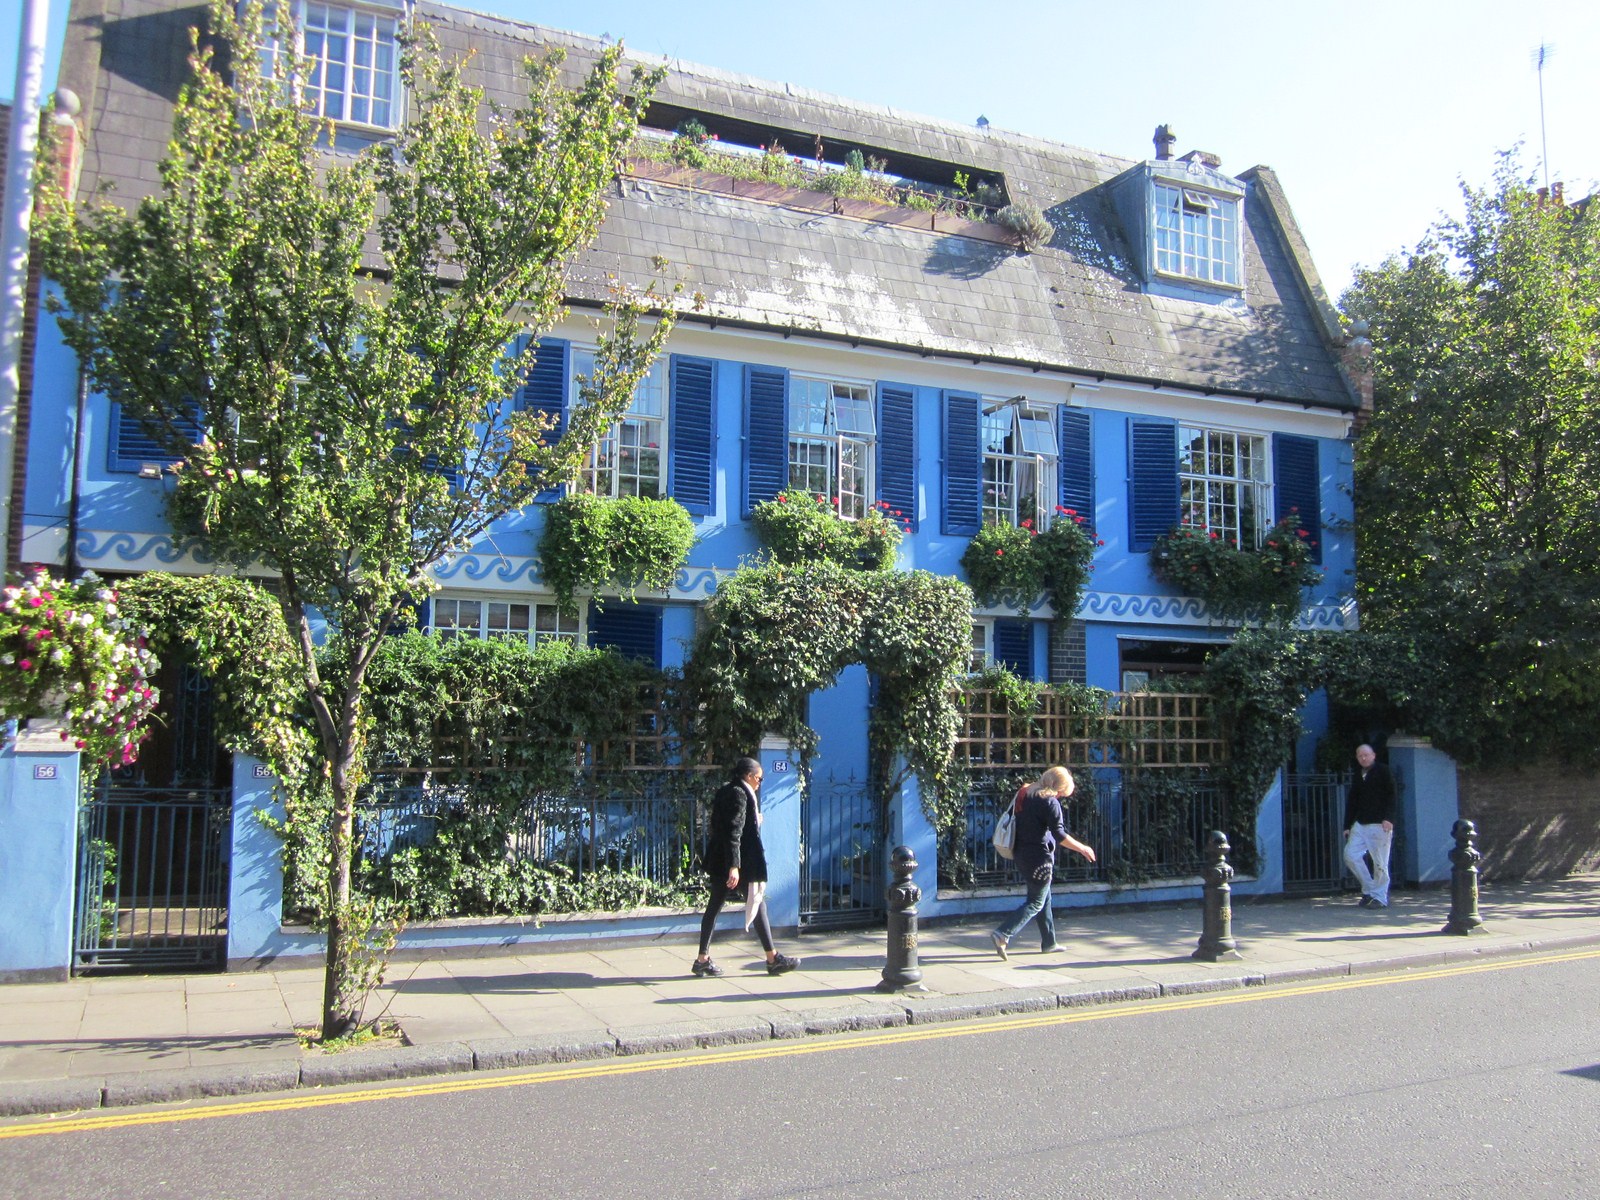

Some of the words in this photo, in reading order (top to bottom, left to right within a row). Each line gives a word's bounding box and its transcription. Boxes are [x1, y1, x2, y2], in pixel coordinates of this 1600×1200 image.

[38, 766, 54, 777] 56
[256, 766, 270, 776] 56
[775, 762, 787, 771] 54
